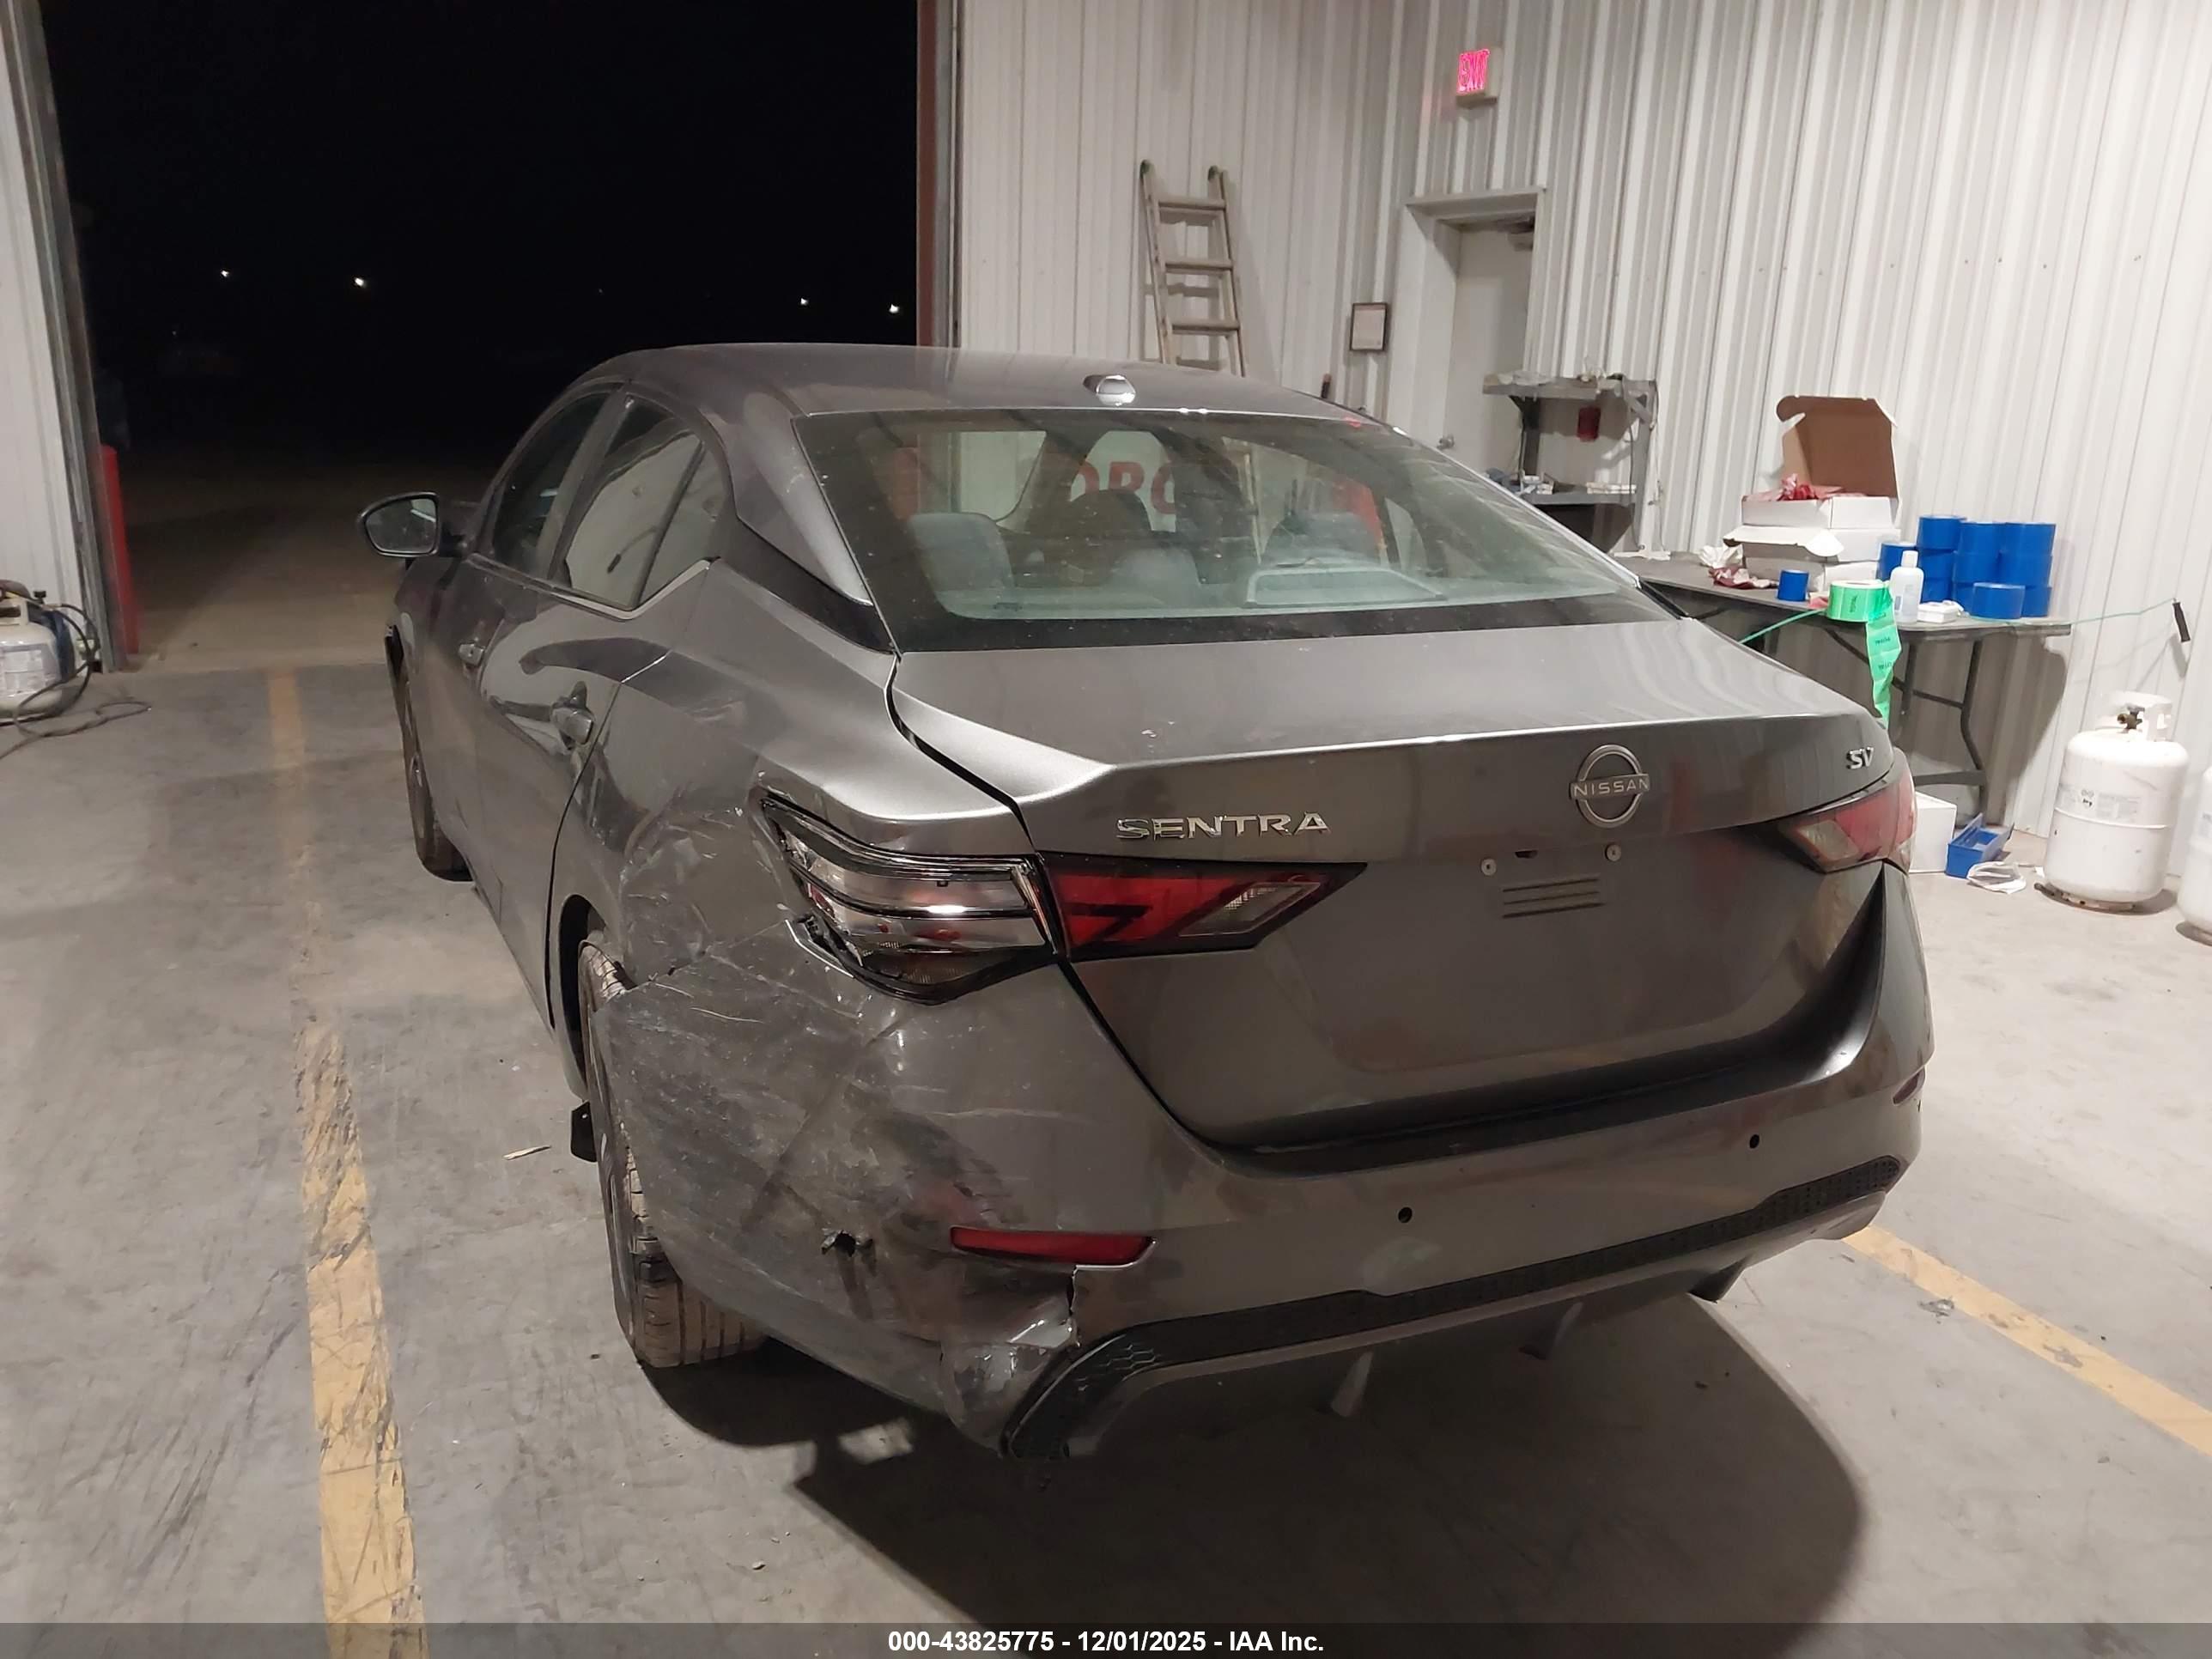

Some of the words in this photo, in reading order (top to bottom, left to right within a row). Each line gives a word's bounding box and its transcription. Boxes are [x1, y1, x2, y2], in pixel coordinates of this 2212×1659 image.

[1846, 747, 1875, 769] SV
[1573, 778, 1649, 797] NISSAN
[1115, 811, 1329, 841] SENTRA
